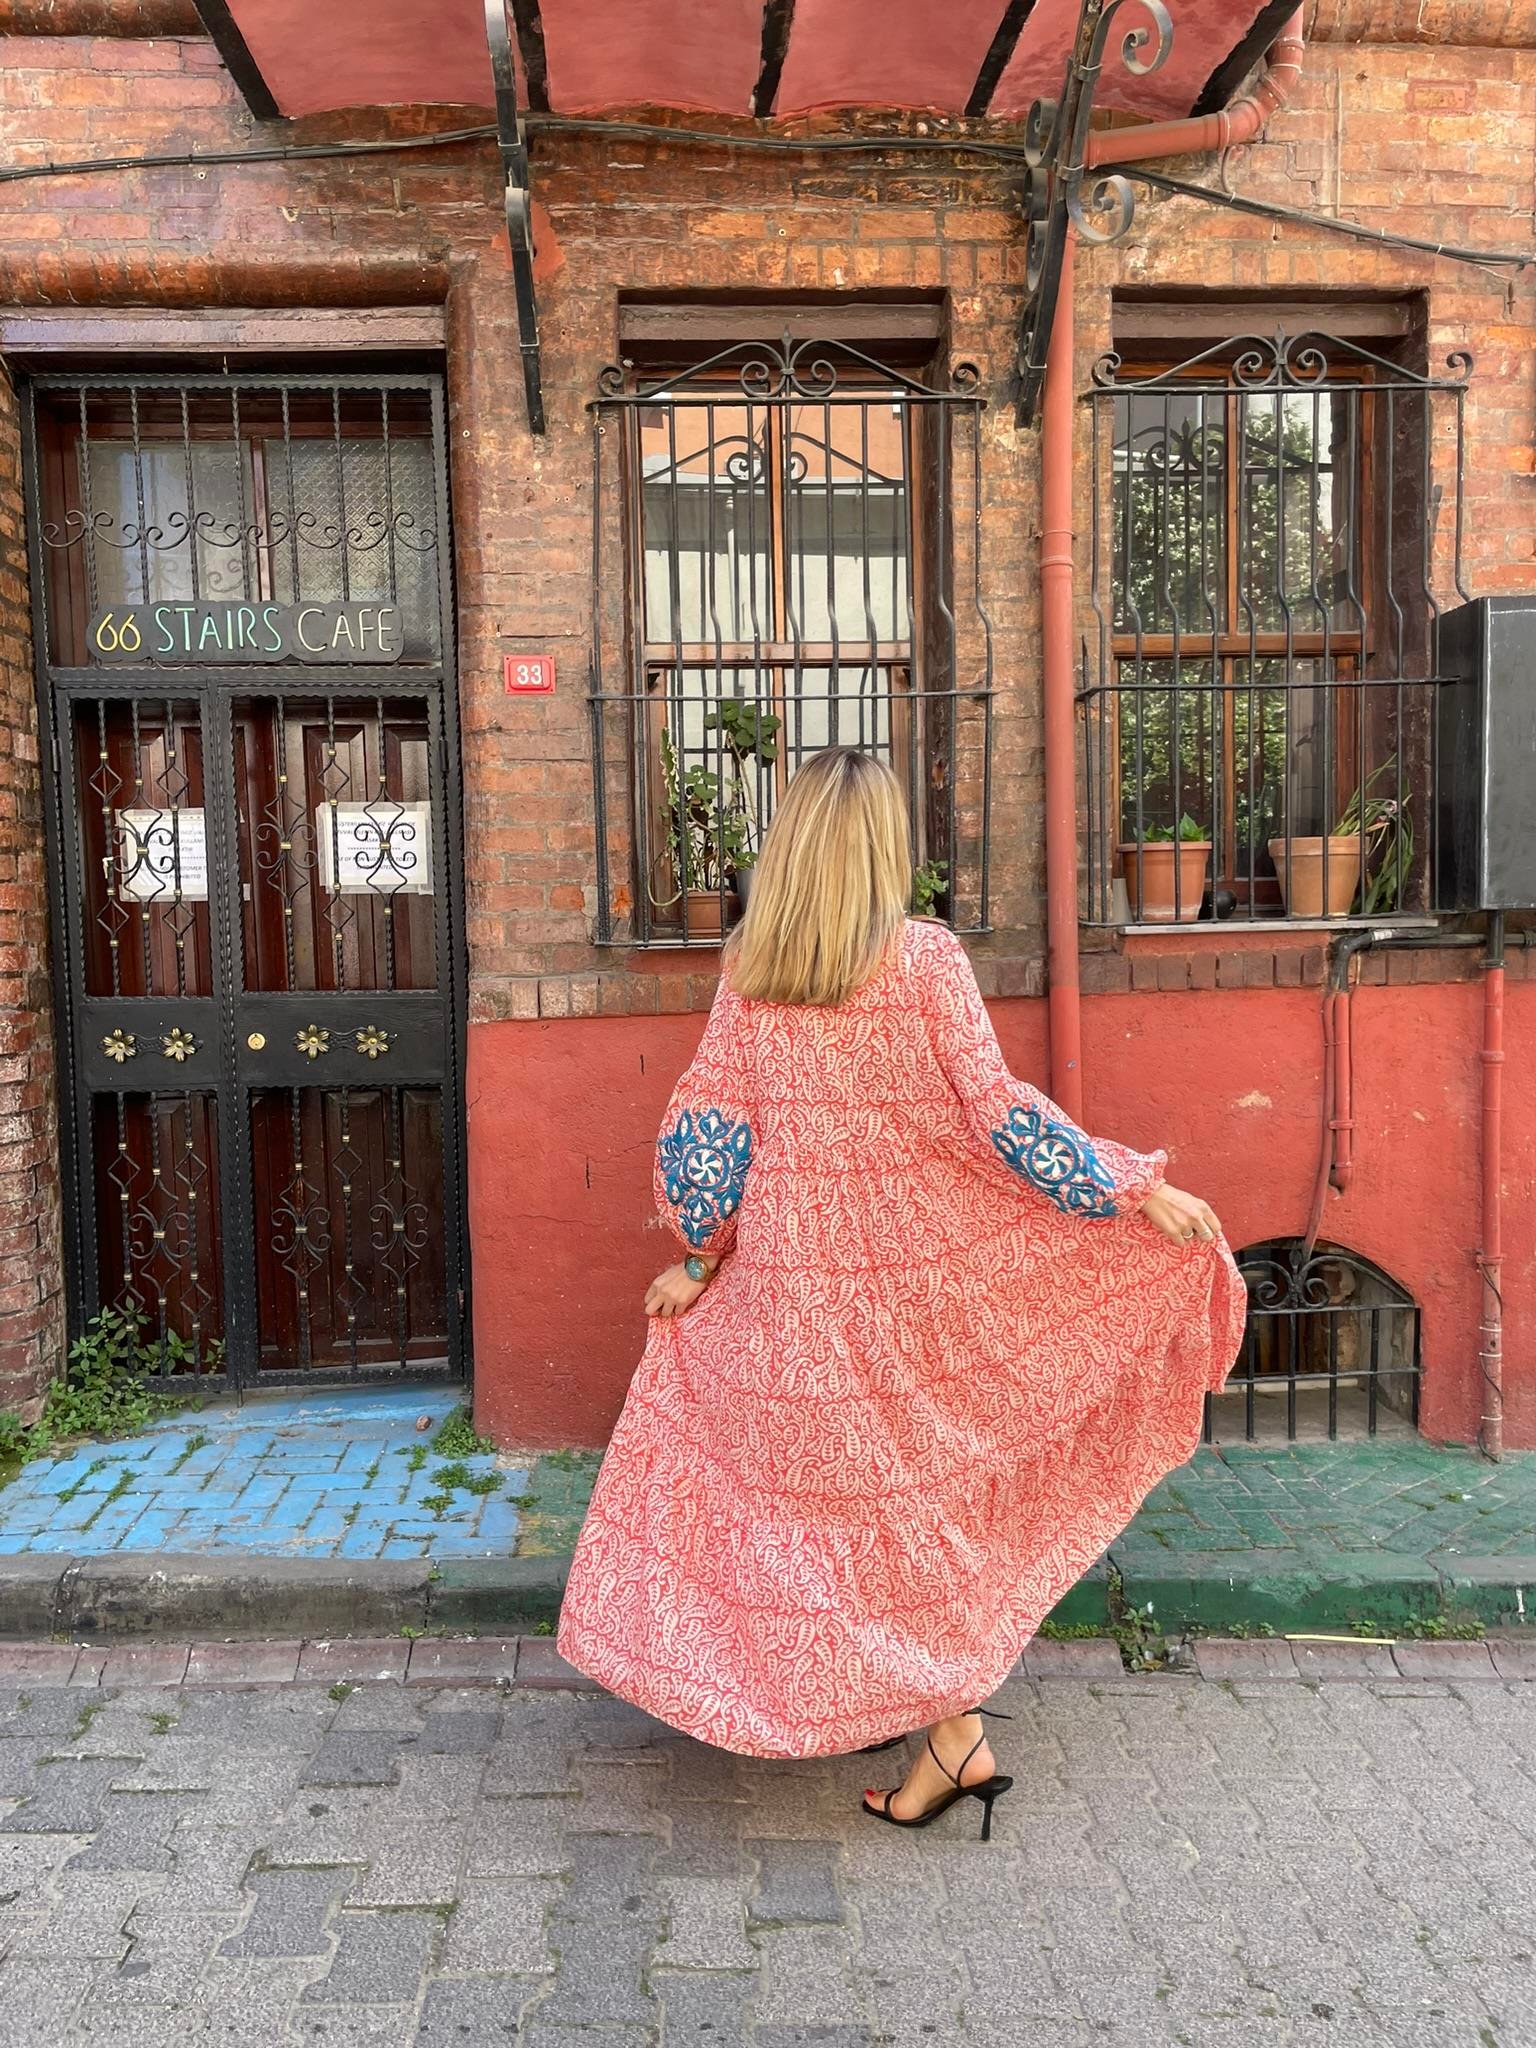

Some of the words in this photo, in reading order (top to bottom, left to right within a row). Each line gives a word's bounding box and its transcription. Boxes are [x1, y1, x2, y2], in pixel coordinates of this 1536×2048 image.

[96, 611, 142, 652] 66
[155, 606, 282, 652] STAIRS
[297, 607, 394, 652] CAFE
[516, 664, 543, 686] 33
